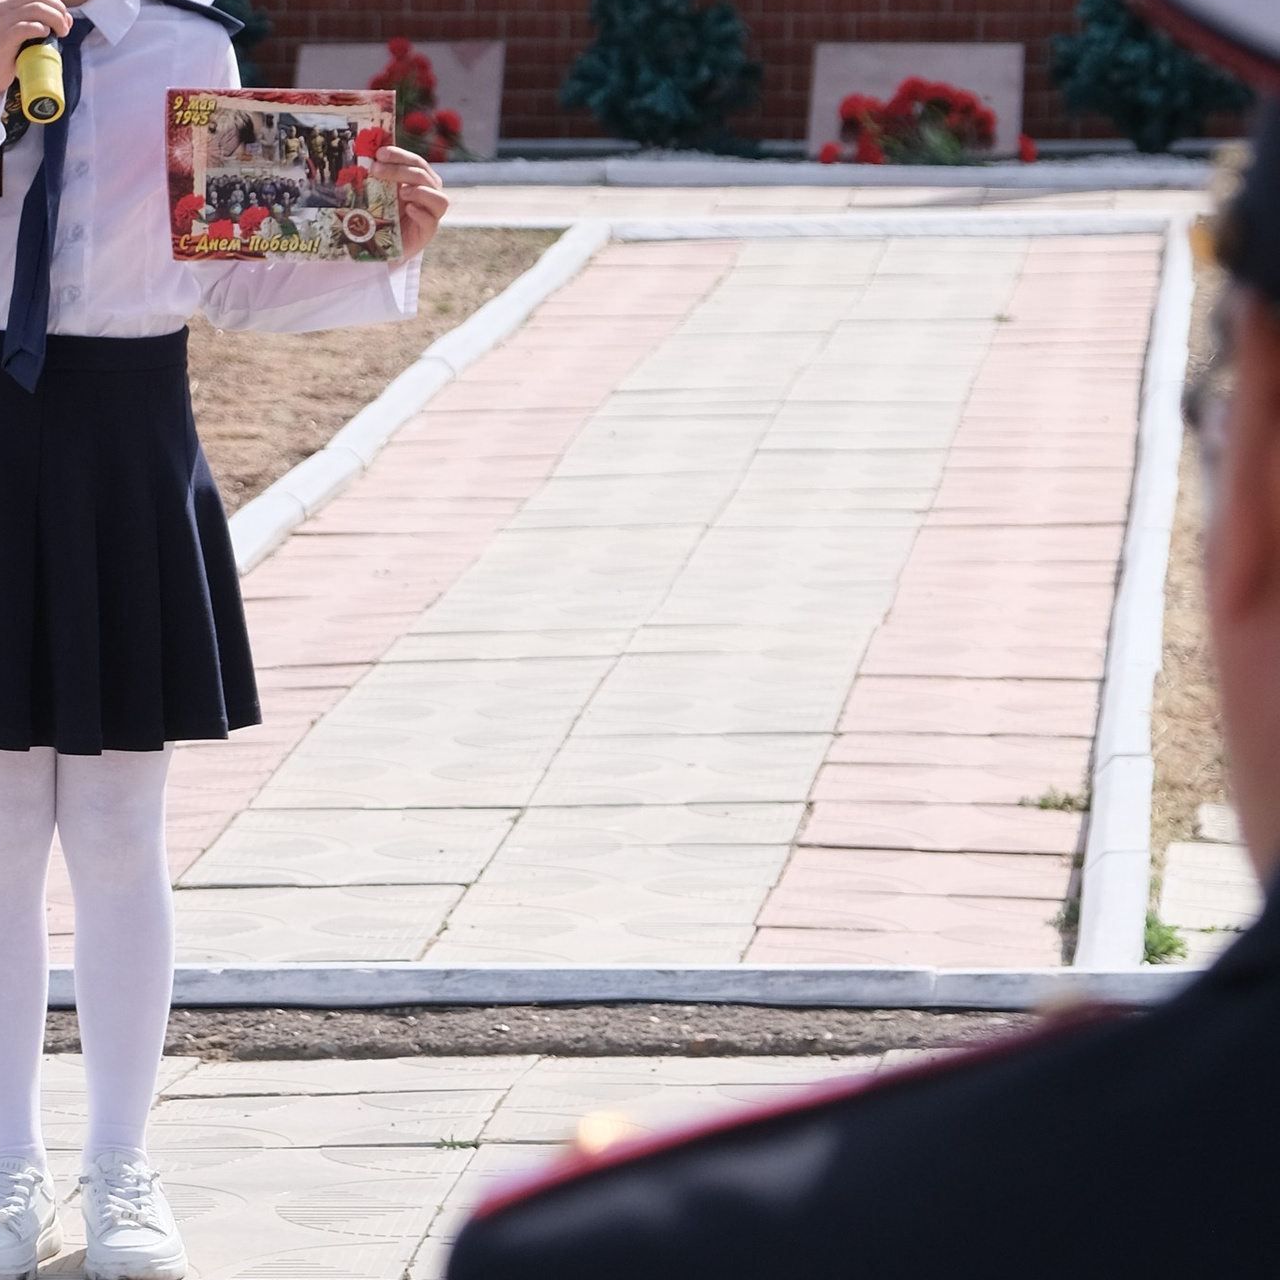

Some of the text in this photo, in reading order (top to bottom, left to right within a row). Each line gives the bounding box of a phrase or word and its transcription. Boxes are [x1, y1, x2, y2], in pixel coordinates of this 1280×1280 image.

[173, 95, 216, 111] 9 мая
[174, 110, 210, 126] 1945
[179, 234, 321, 253] С Днем Победы!
